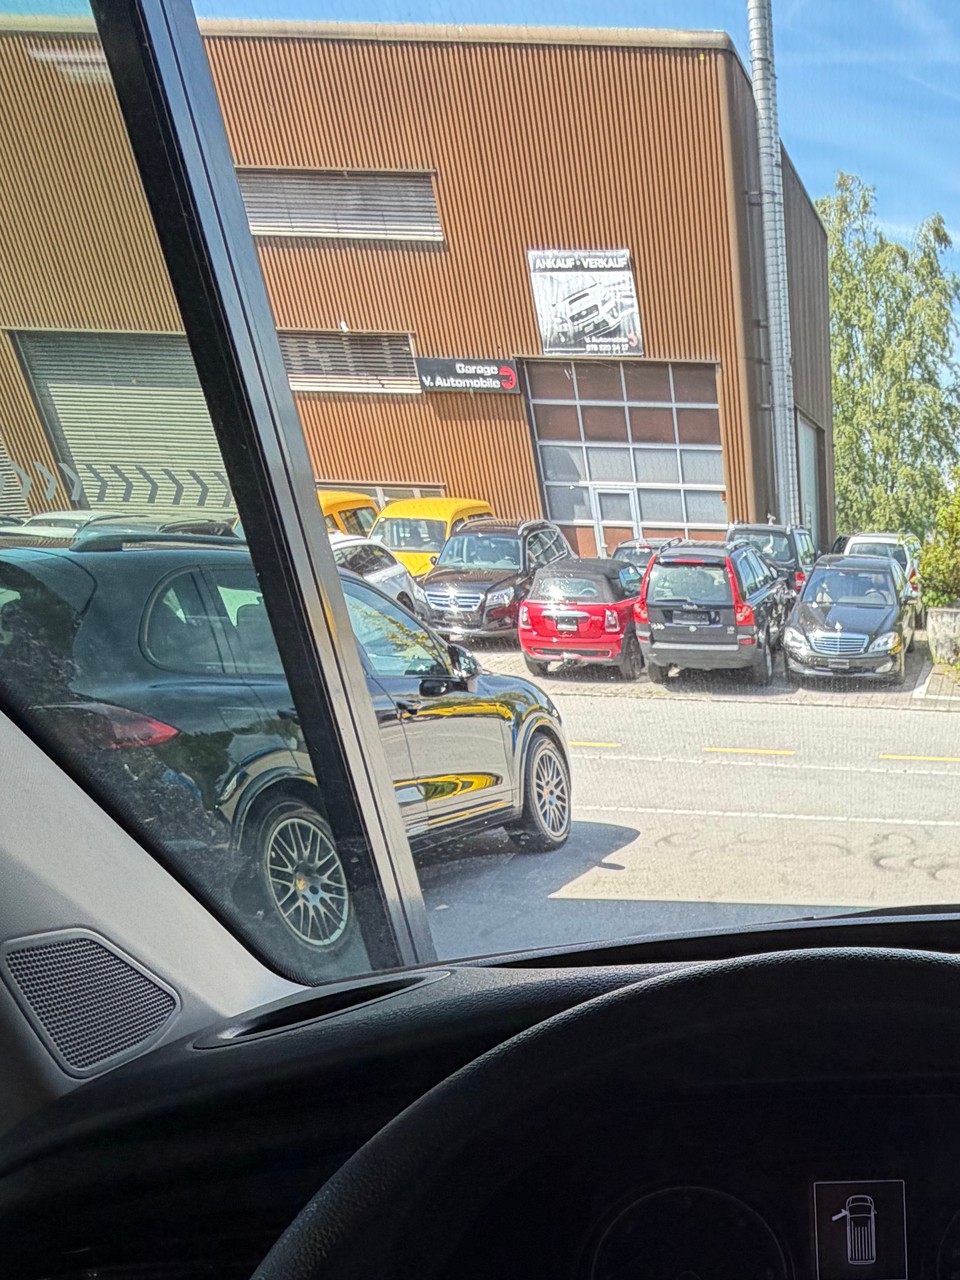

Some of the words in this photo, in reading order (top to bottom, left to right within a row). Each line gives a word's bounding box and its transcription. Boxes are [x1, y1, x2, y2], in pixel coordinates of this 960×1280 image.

[536, 257, 575, 269] ANKAUF
[582, 257, 628, 269] VERKAUF
[455, 363, 498, 376] Garage
[422, 375, 433, 387] V.
[435, 377, 501, 388] Automobile
